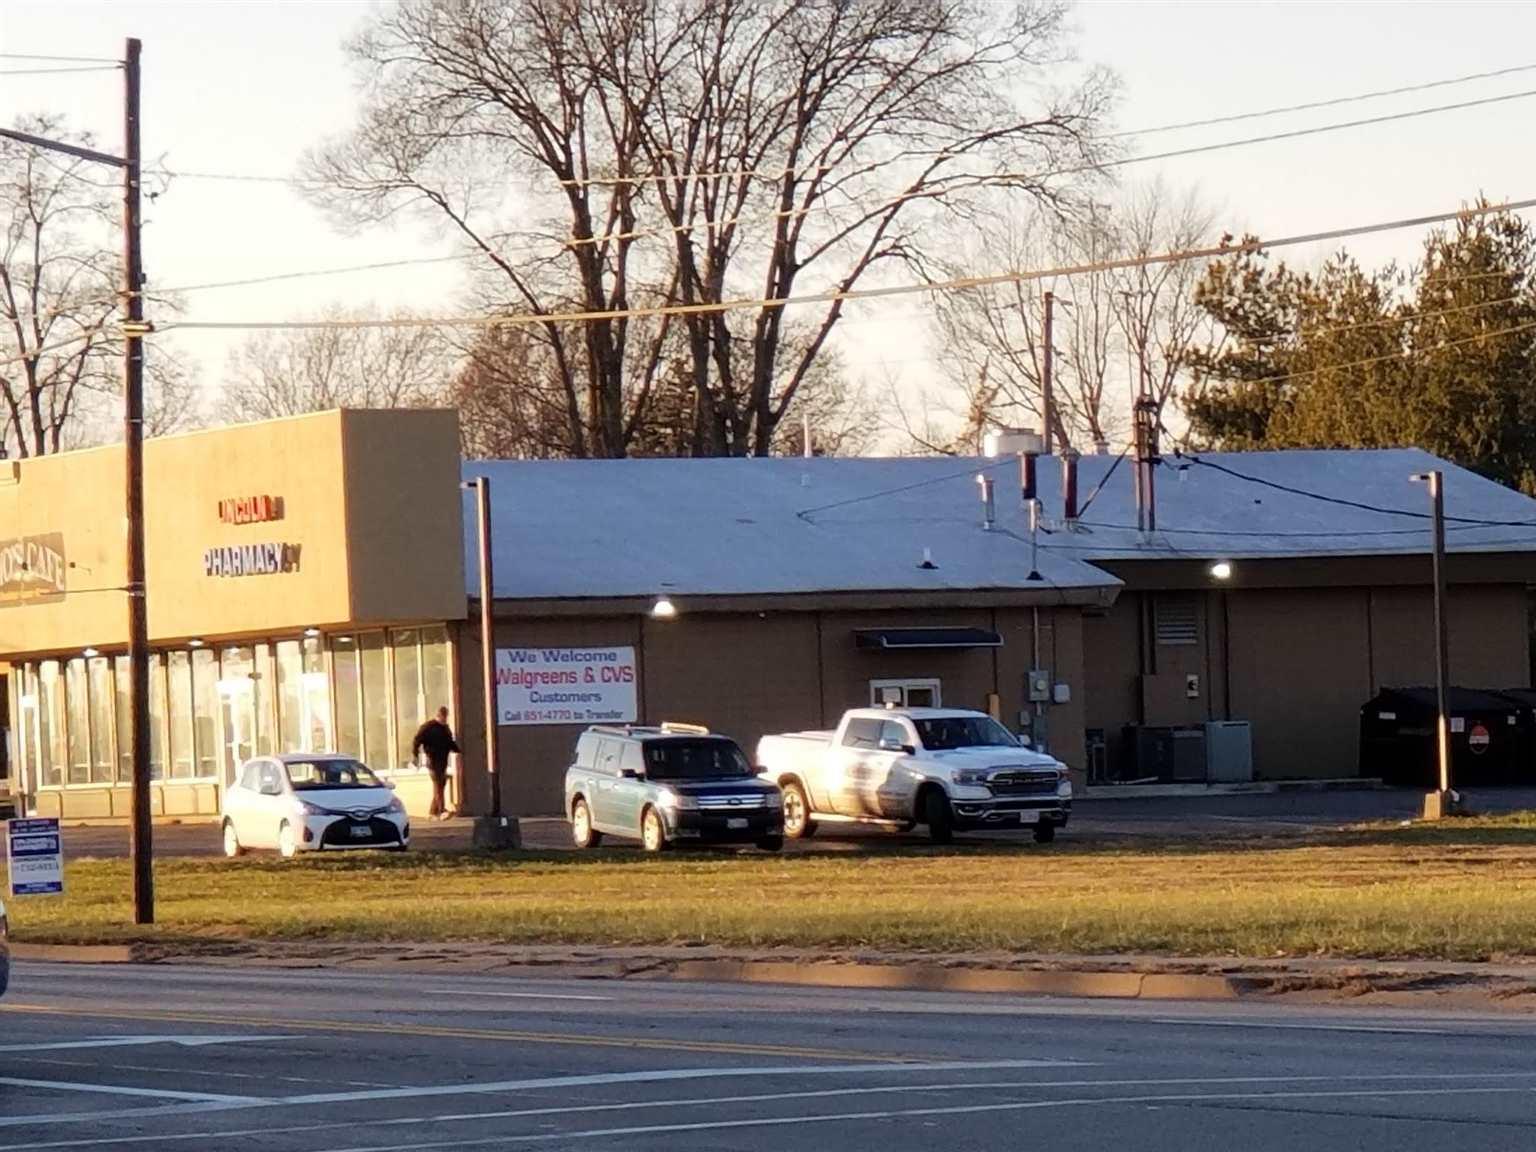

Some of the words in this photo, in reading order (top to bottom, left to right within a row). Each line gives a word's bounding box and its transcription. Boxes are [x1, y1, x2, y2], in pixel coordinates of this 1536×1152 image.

[204, 543, 294, 577] PHARMACY
[508, 650, 537, 663] We
[542, 649, 617, 663] Welcome
[495, 667, 578, 689] Walgreens
[583, 667, 595, 684] &
[601, 665, 634, 683] CVS
[529, 691, 603, 703] Customers
[504, 711, 521, 721] Call
[574, 710, 584, 719] to
[585, 709, 624, 720] Transfer
